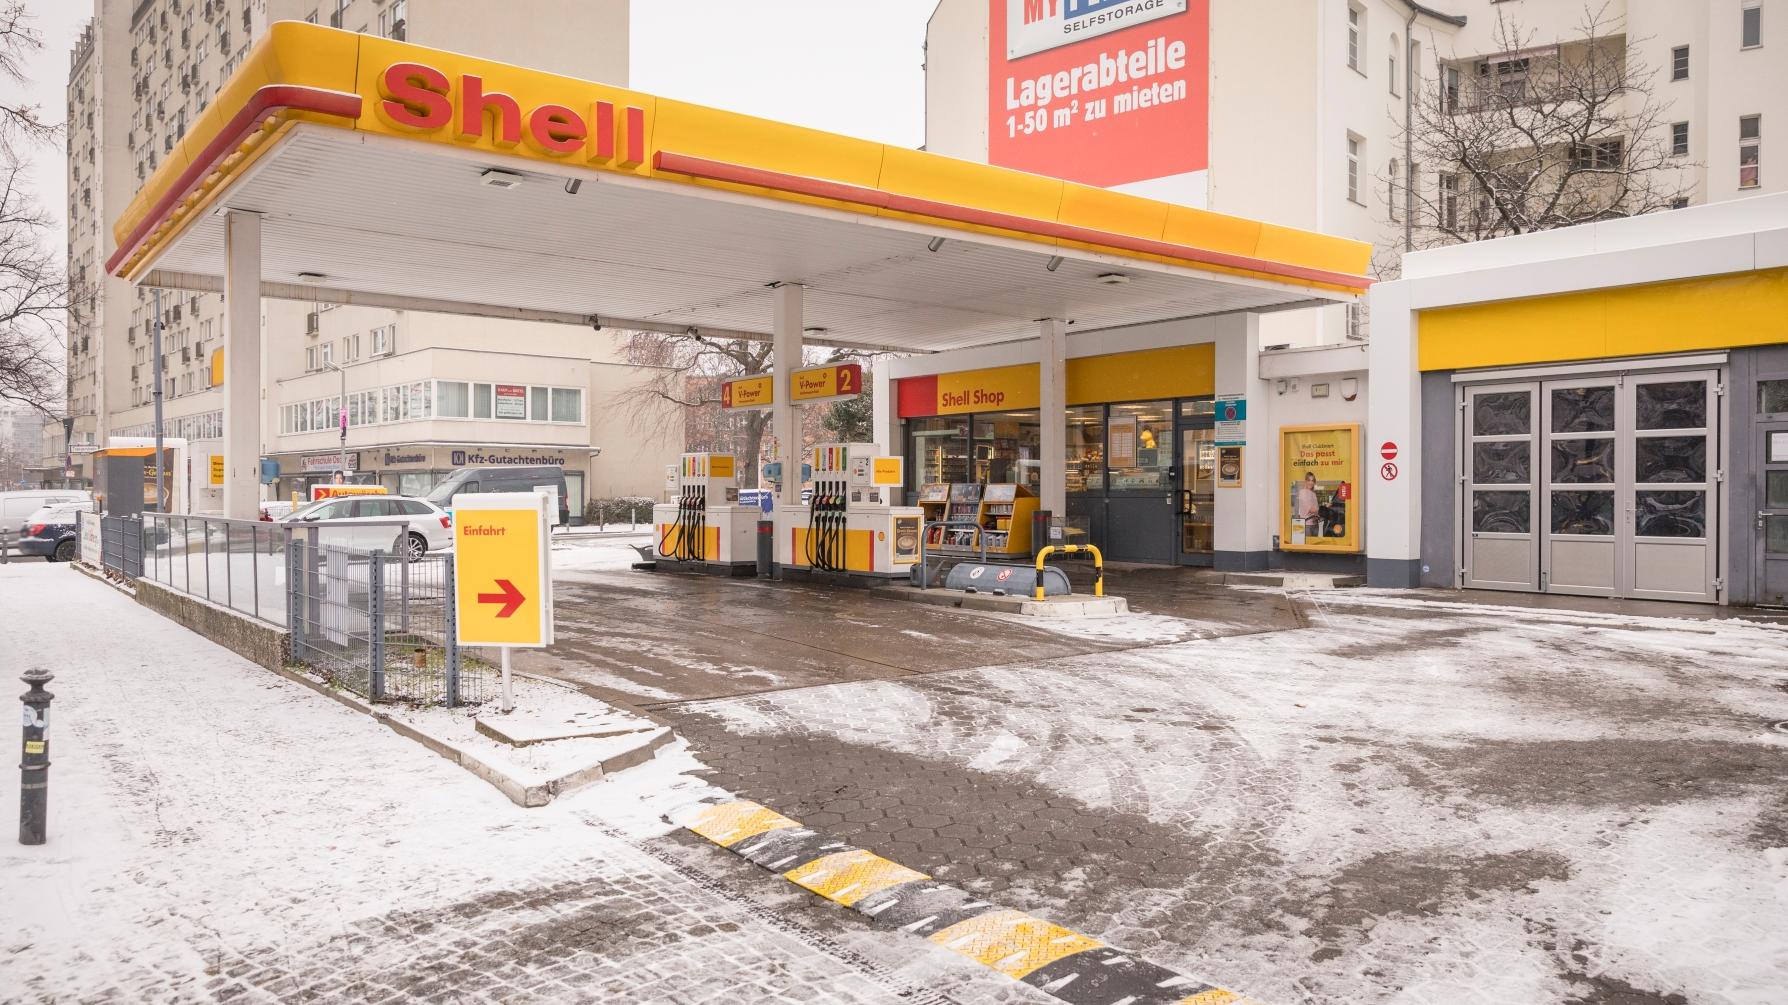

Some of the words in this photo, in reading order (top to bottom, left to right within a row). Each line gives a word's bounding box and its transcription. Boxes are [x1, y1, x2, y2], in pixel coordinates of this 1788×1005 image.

[1063, 0, 1164, 34] SELFSTORAGE
[1006, 37, 1187, 110] Lagerabteile
[378, 62, 644, 168] Shell
[1006, 108, 1048, 138] 1-50
[1085, 99, 1107, 122] zu
[1113, 79, 1187, 114] mieten
[799, 380, 826, 390] V-Power
[840, 369, 852, 391] 2
[723, 385, 731, 405] 4
[738, 389, 761, 399] V-Power
[942, 390, 970, 407] Shell
[973, 388, 1005, 406] Shop
[468, 454, 565, 466] Kfz-Gutachtenbüro
[1293, 458, 1319, 467] einfach
[1331, 458, 1344, 466] mir
[1300, 450, 1314, 458] Das
[1315, 450, 1336, 459] passt
[463, 524, 506, 536] Einfahrt
